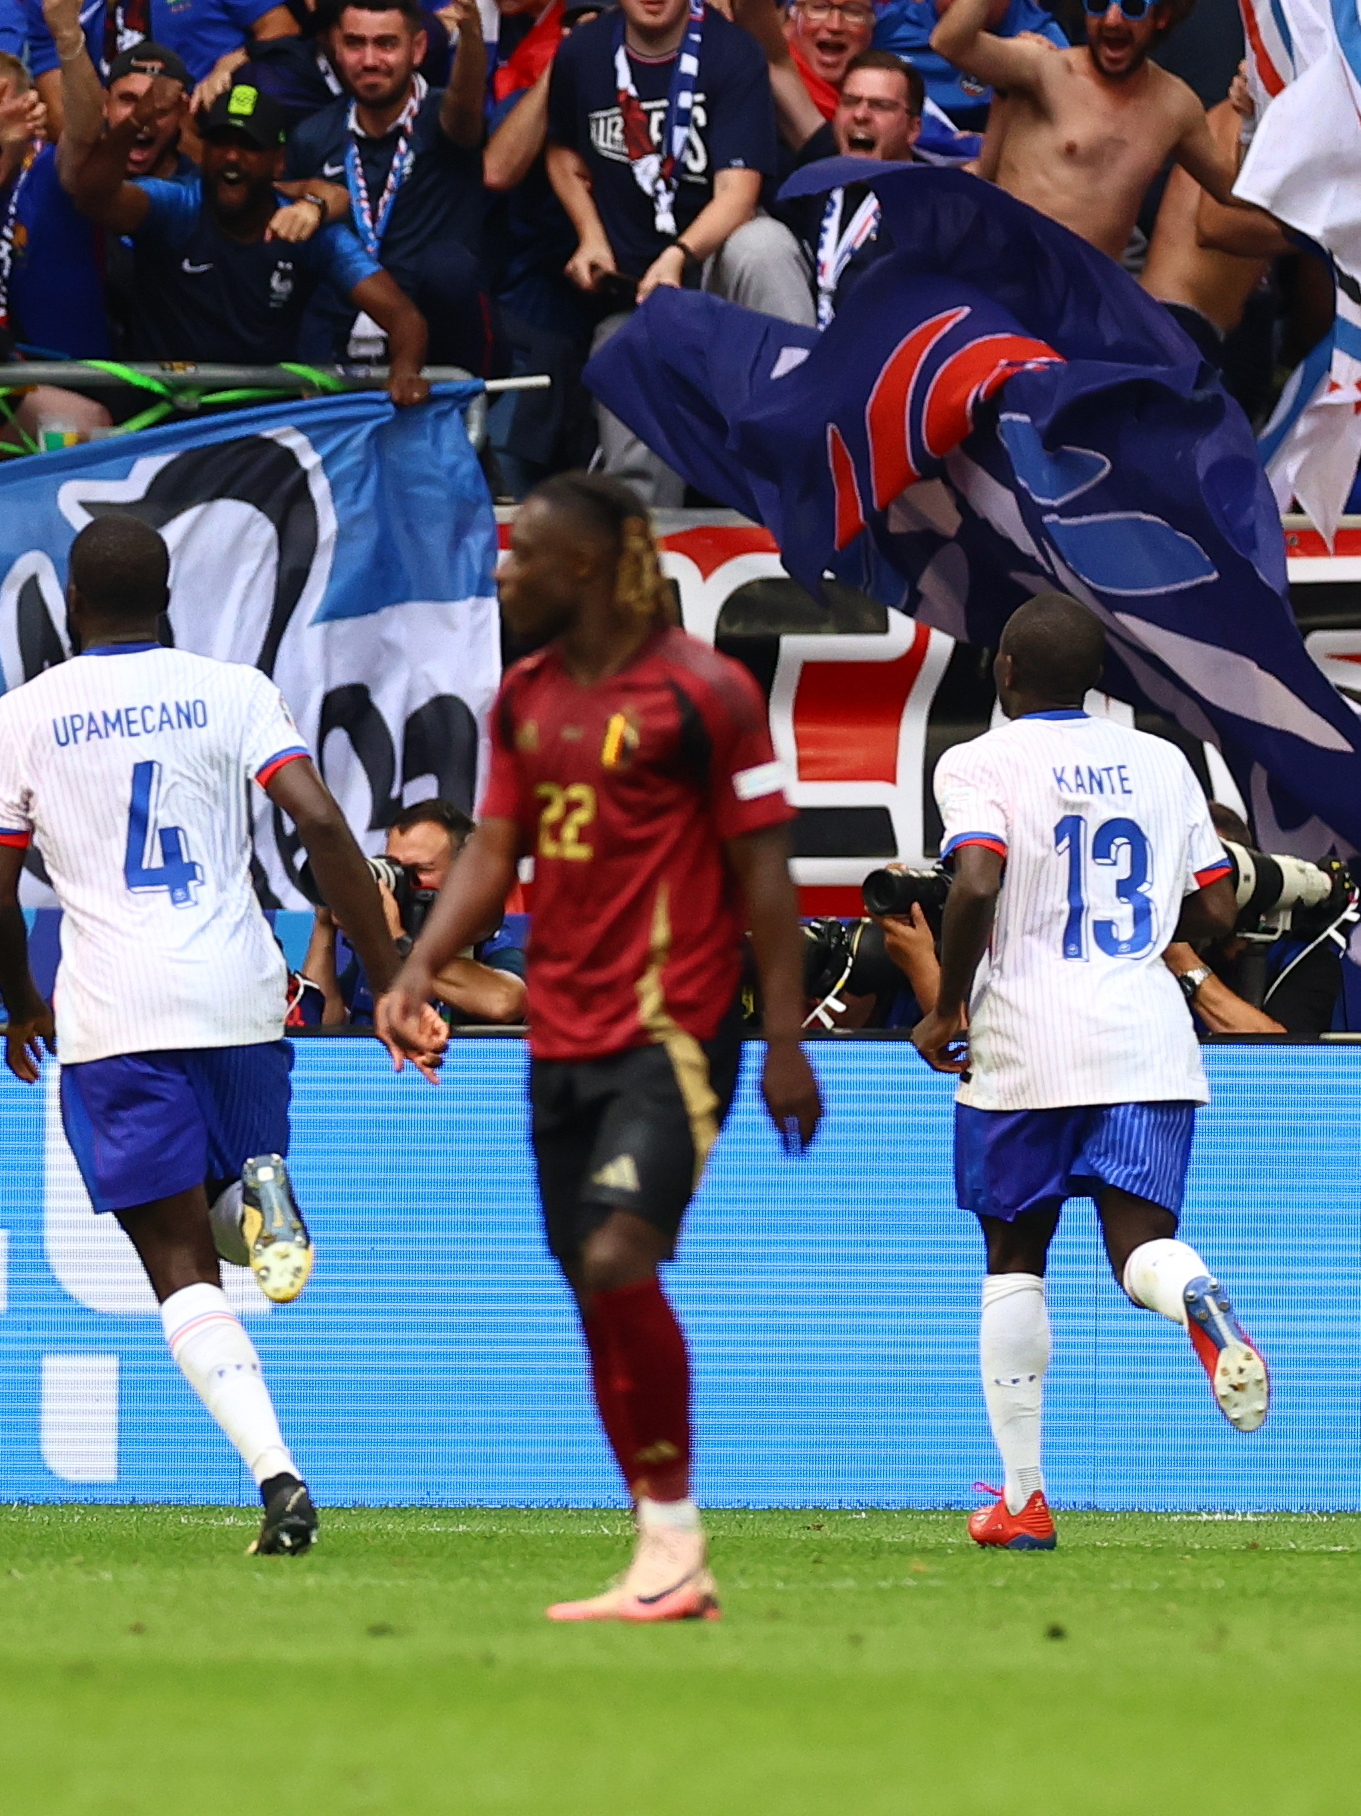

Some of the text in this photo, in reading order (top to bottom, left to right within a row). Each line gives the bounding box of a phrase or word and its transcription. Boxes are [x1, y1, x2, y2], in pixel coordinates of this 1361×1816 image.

[53, 698, 208, 748] UPAMECANO
[1052, 764, 1134, 795] KANTE
[124, 760, 205, 909] 4
[534, 783, 597, 862] 22
[1053, 814, 1162, 960] 13
